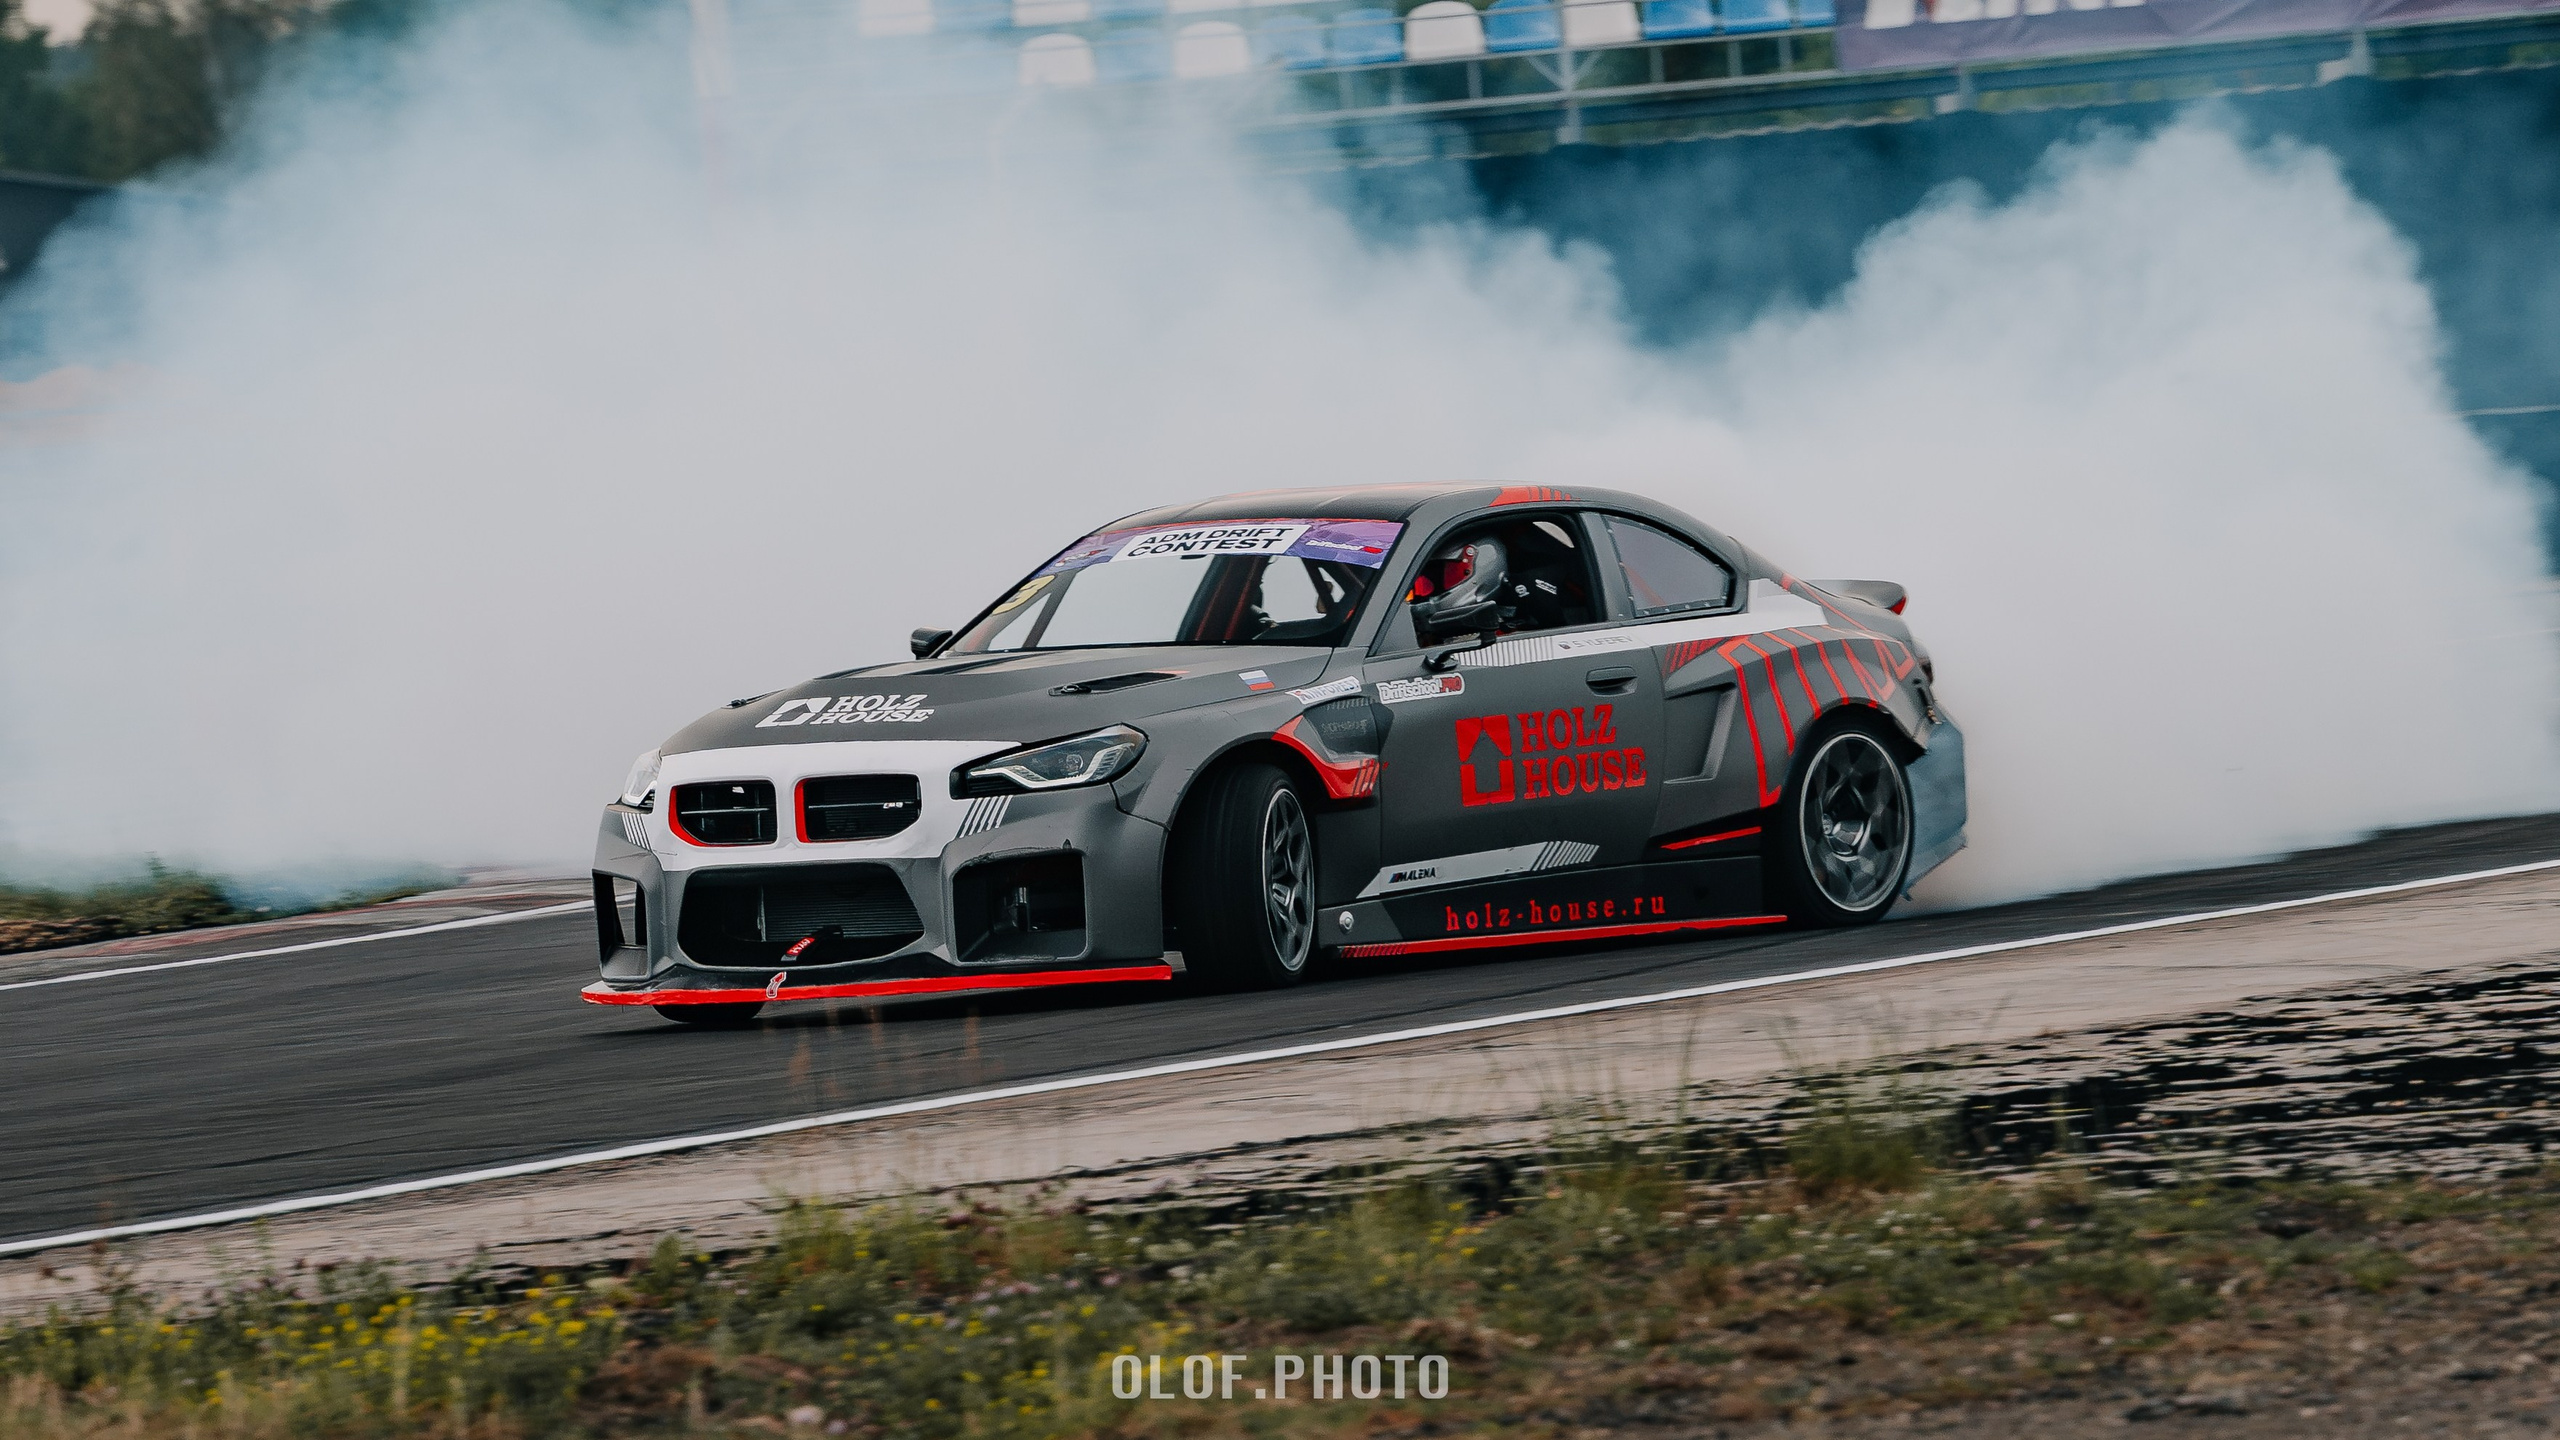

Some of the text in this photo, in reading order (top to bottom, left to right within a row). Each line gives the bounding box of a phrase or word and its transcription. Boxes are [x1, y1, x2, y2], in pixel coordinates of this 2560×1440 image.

[1139, 527, 1294, 546] ADM DRIFT
[1127, 538, 1283, 557] CONTEST
[828, 694, 928, 713] HOLZ
[809, 709, 935, 725] HOUSE
[1516, 703, 1617, 753] HOLZ
[1522, 746, 1647, 800] HOUSE
[1445, 896, 1666, 932] holz-house.ru
